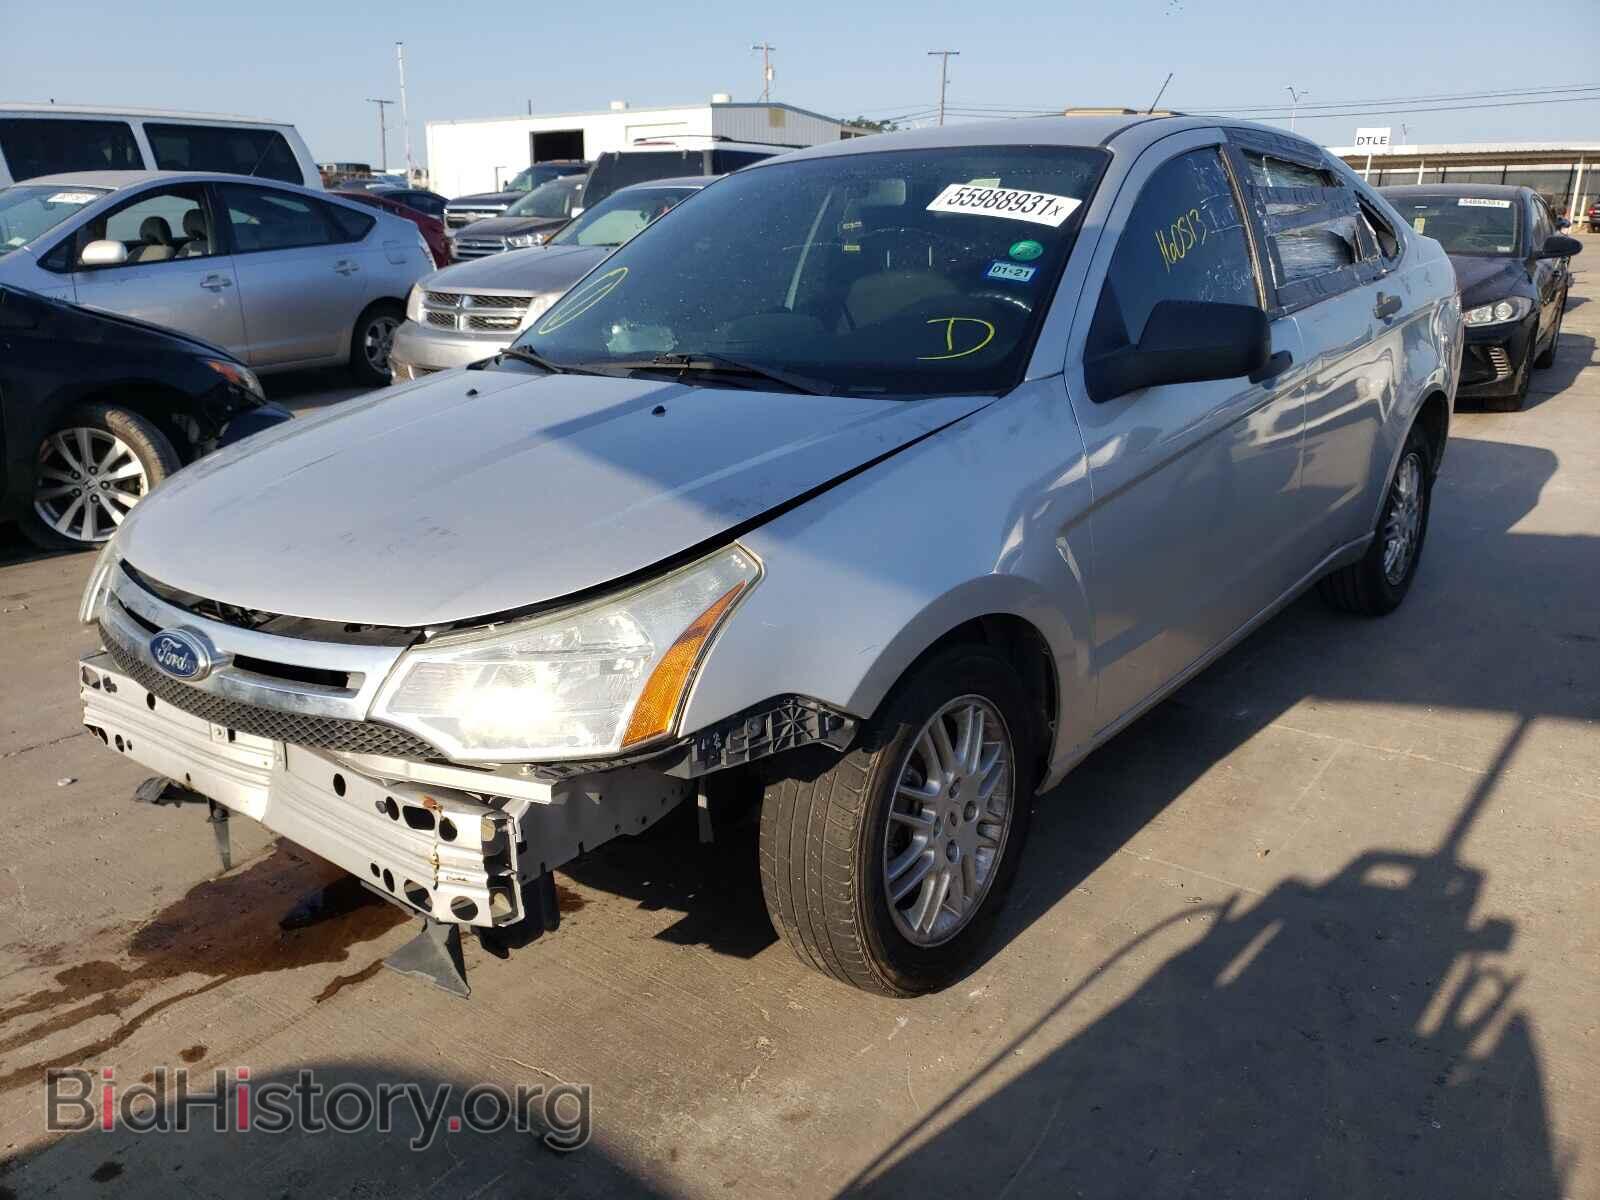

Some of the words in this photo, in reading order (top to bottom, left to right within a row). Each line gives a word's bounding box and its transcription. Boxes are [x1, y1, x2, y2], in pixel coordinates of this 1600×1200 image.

[1357, 136, 1387, 145] DTLE
[992, 266, 1031, 278] 01-21
[157, 637, 188, 671] Ford
